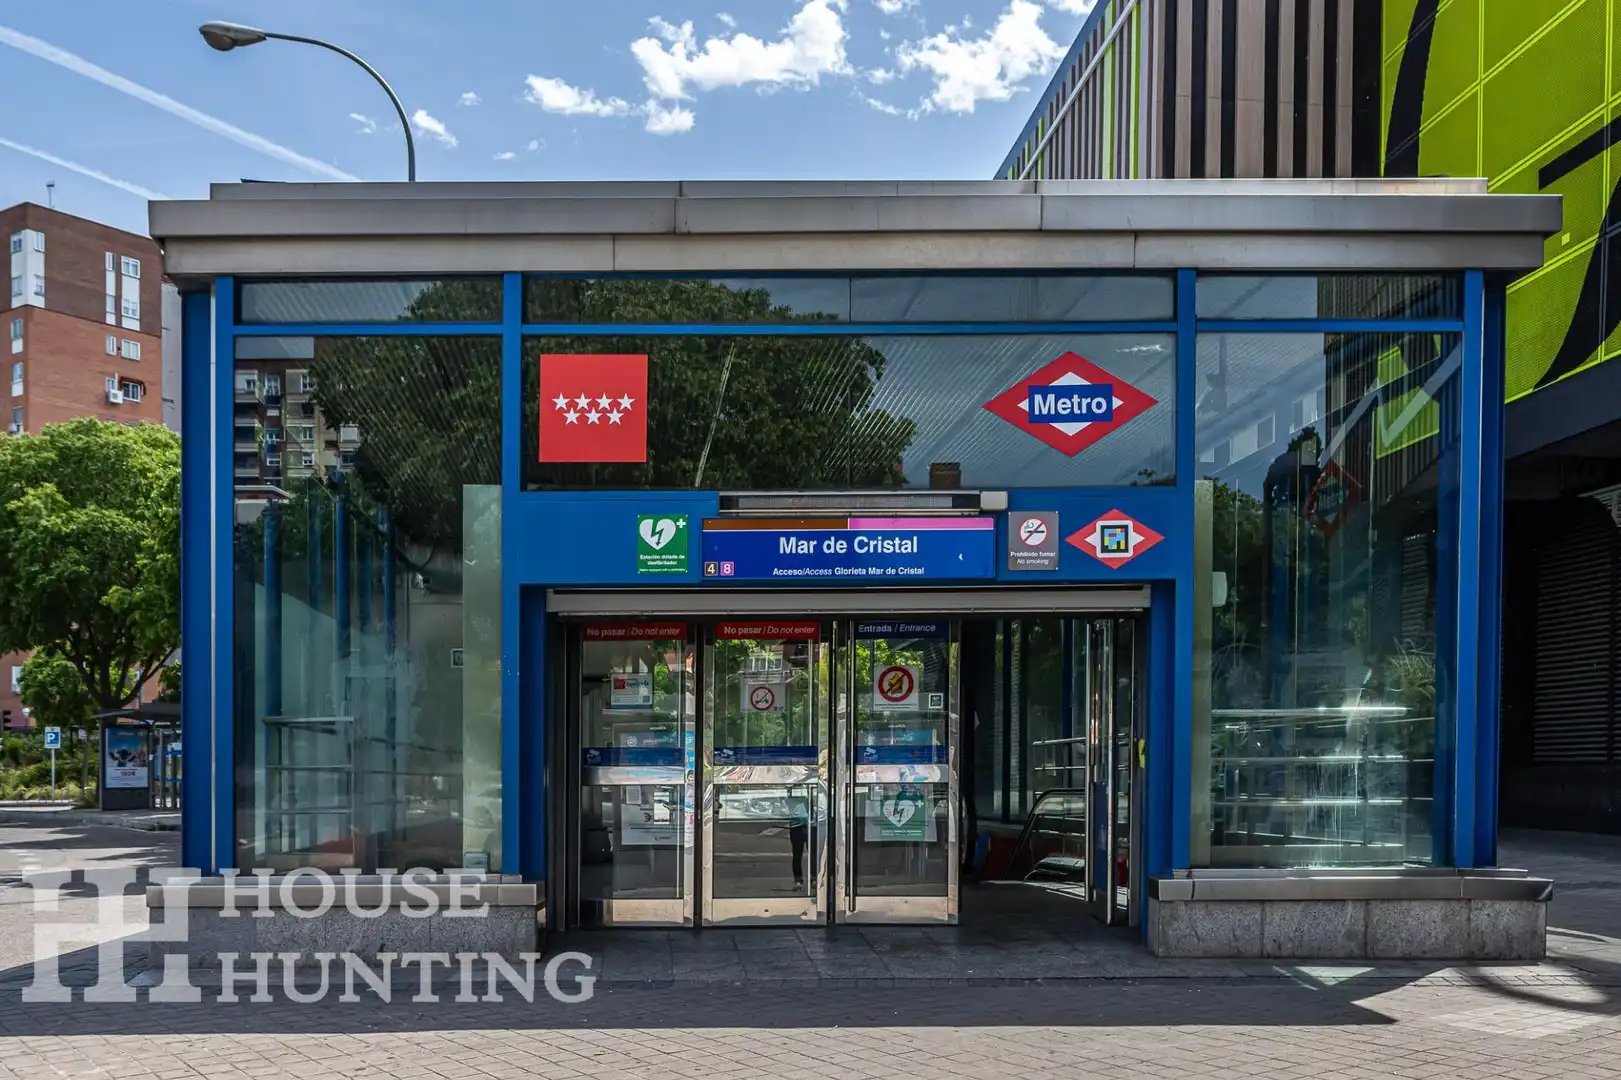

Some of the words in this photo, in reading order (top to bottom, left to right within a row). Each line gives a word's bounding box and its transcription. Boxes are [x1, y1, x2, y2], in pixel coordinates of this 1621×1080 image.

[1034, 394, 1107, 415] Metro
[779, 536, 817, 554] Mar
[822, 536, 848, 554] de
[853, 536, 918, 554] Cristal
[707, 563, 716, 574] 4
[723, 563, 731, 574] 8
[772, 567, 832, 576] Acceso/Access
[834, 567, 867, 575] Glorieta
[868, 567, 884, 575] Mar
[885, 567, 896, 575] de
[898, 567, 925, 575] Cristal
[586, 627, 599, 636] No
[601, 628, 626, 637] pasar
[631, 627, 643, 635] Do
[644, 627, 658, 635] not
[658, 627, 680, 635] enter
[724, 626, 737, 634] No
[738, 626, 761, 636] pasar
[767, 626, 779, 634] Do
[780, 626, 794, 634] not
[794, 625, 815, 634] enter
[858, 624, 892, 632] Entrada
[899, 624, 936, 632] Entrance
[48, 733, 56, 743] P
